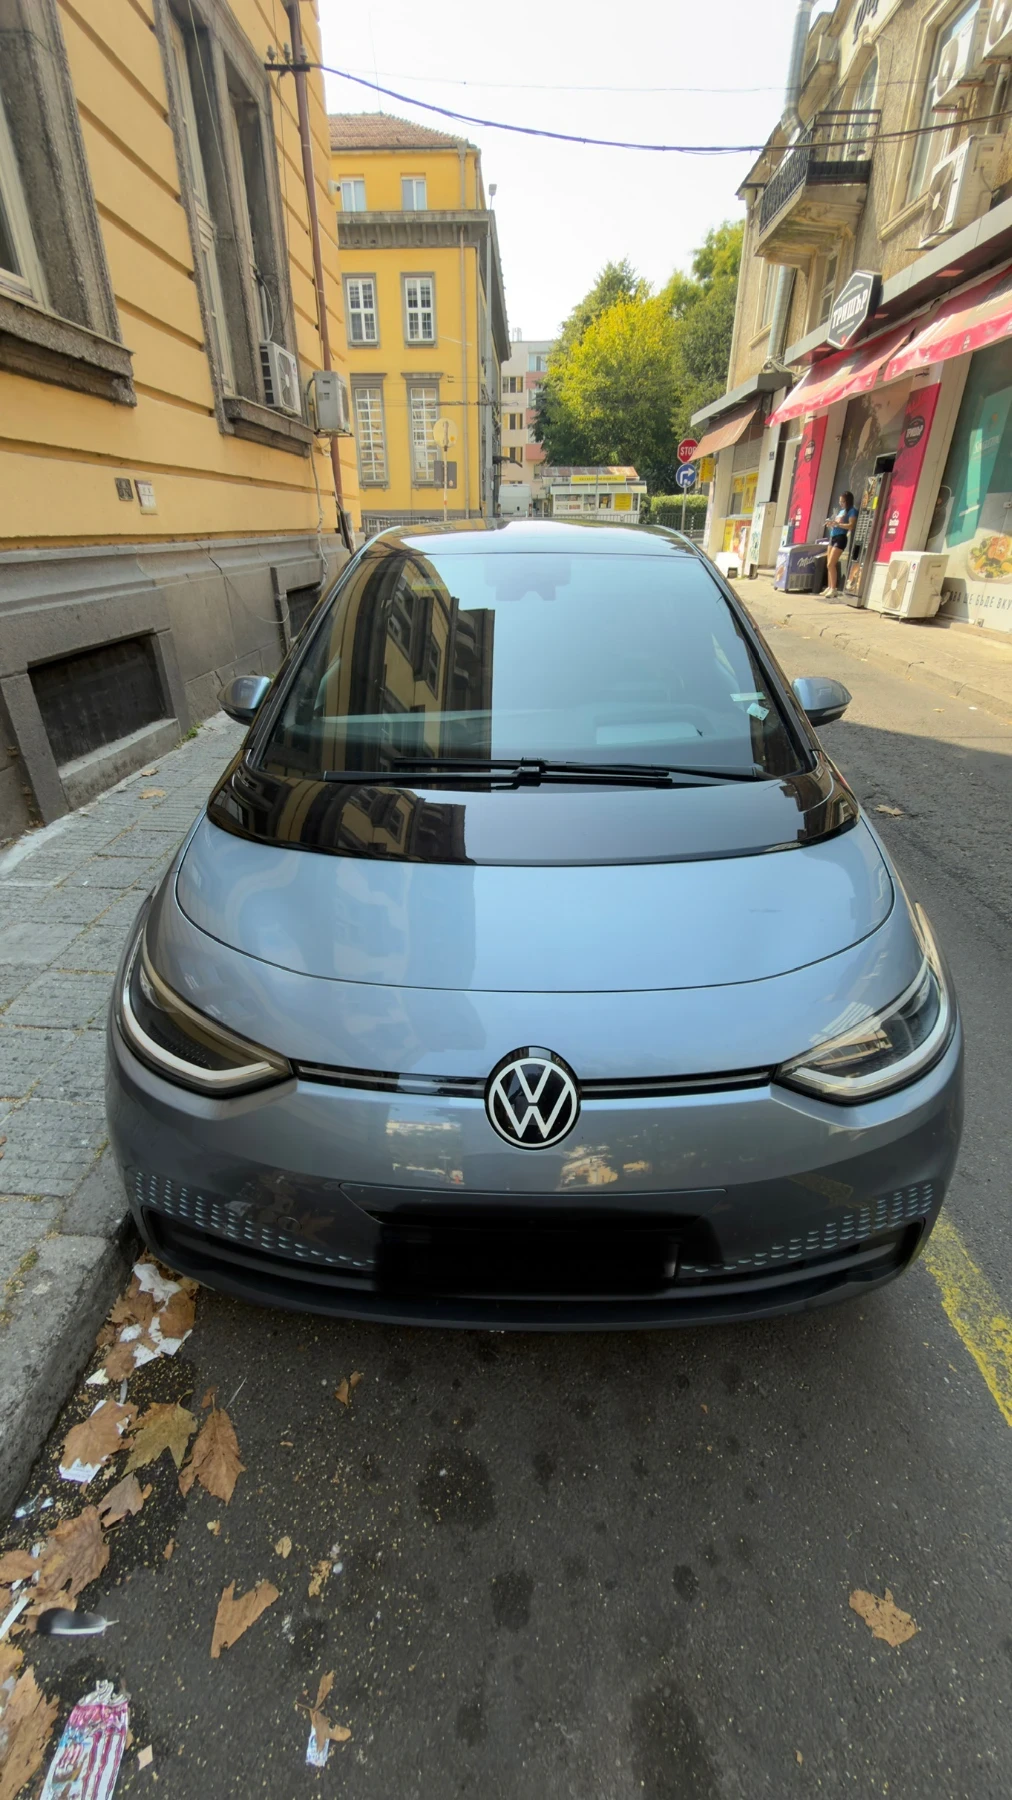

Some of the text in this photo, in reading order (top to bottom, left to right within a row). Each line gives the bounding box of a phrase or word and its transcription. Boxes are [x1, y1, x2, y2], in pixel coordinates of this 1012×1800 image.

[832, 288, 869, 330] ТРИШЪР
[680, 446, 697, 457] STOP
[492, 1062, 573, 1142] VW
